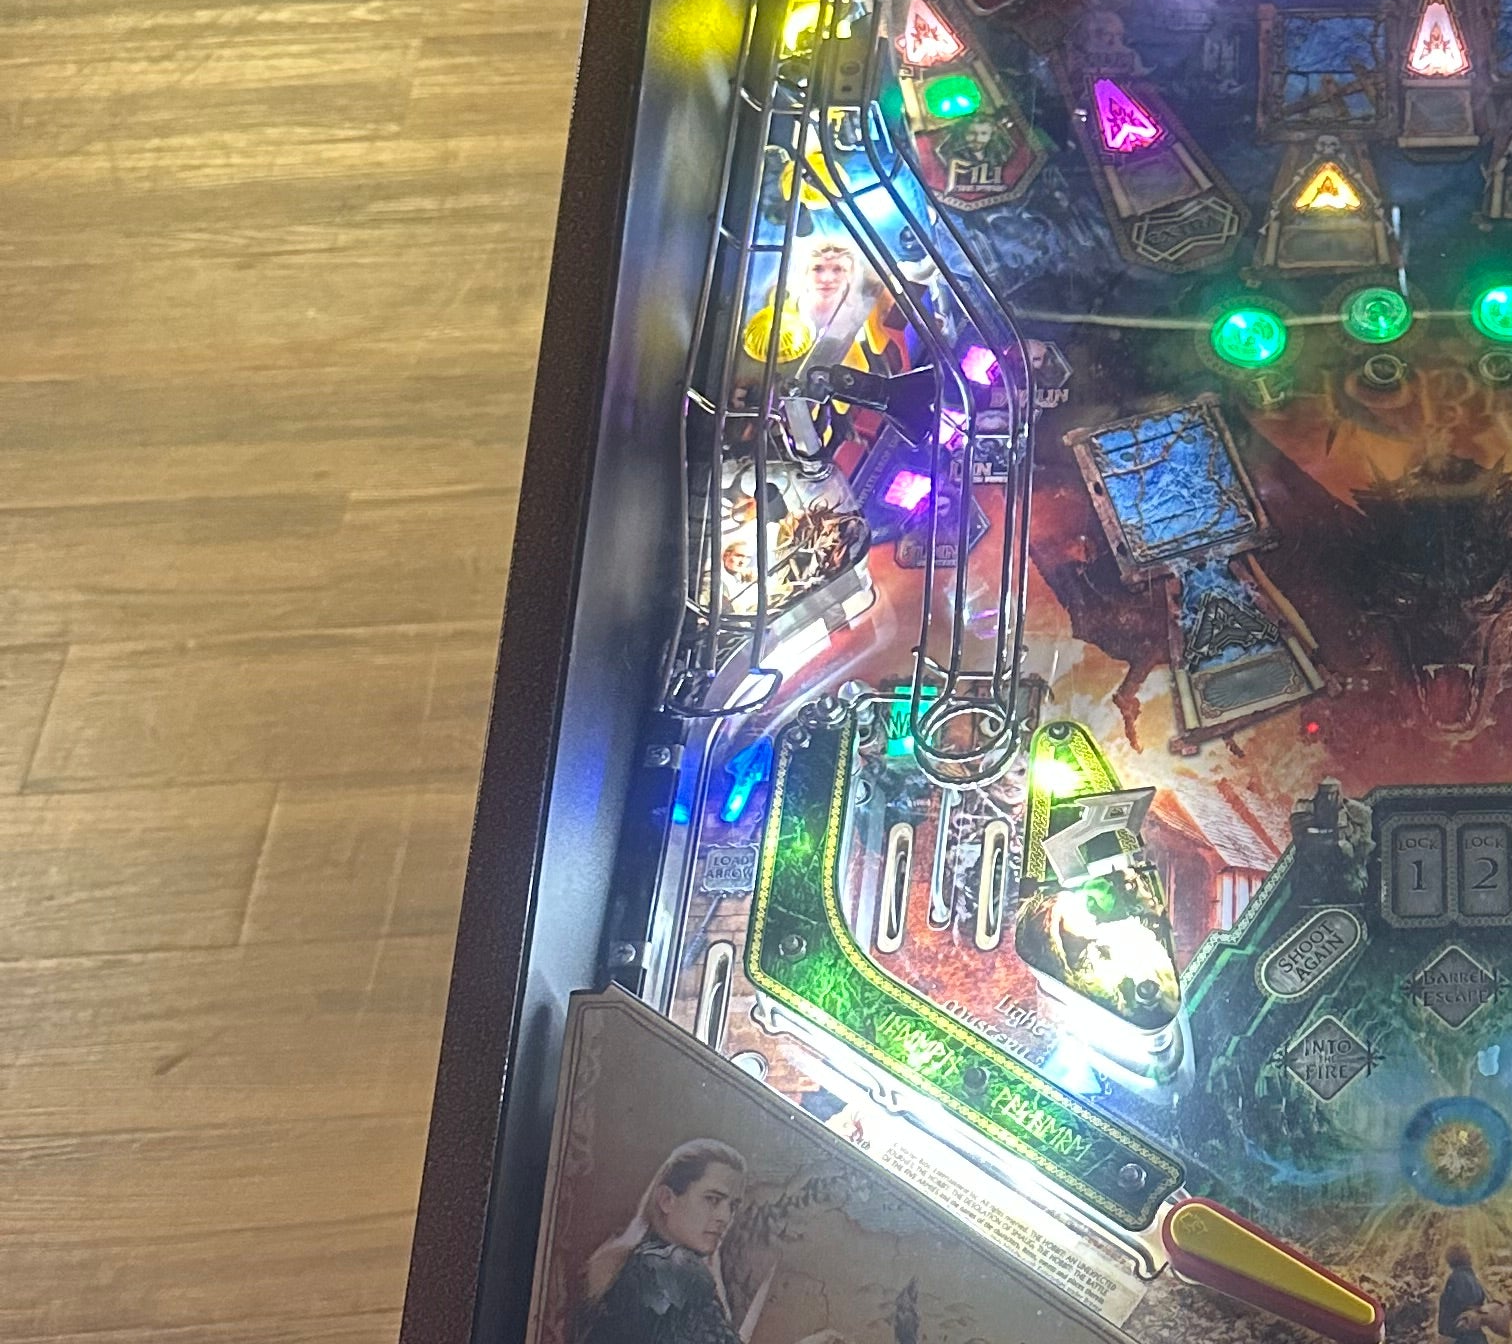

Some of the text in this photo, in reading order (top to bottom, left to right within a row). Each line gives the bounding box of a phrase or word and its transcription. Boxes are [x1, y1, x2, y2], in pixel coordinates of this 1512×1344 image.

[1251, 375, 1286, 407] L
[1399, 836, 1438, 851] LOCK
[1464, 835, 1504, 851] LOCK
[713, 856, 750, 866] LOAD
[1410, 858, 1428, 894] 1
[1470, 856, 1500, 893] 2
[1278, 919, 1335, 973] SHOOT
[1295, 932, 1345, 981] AGAIN
[1422, 969, 1490, 986] BARREL
[1422, 989, 1490, 1007] ESCAPE
[1304, 1039, 1352, 1056] INTO
[1305, 1064, 1349, 1081] FIRE
